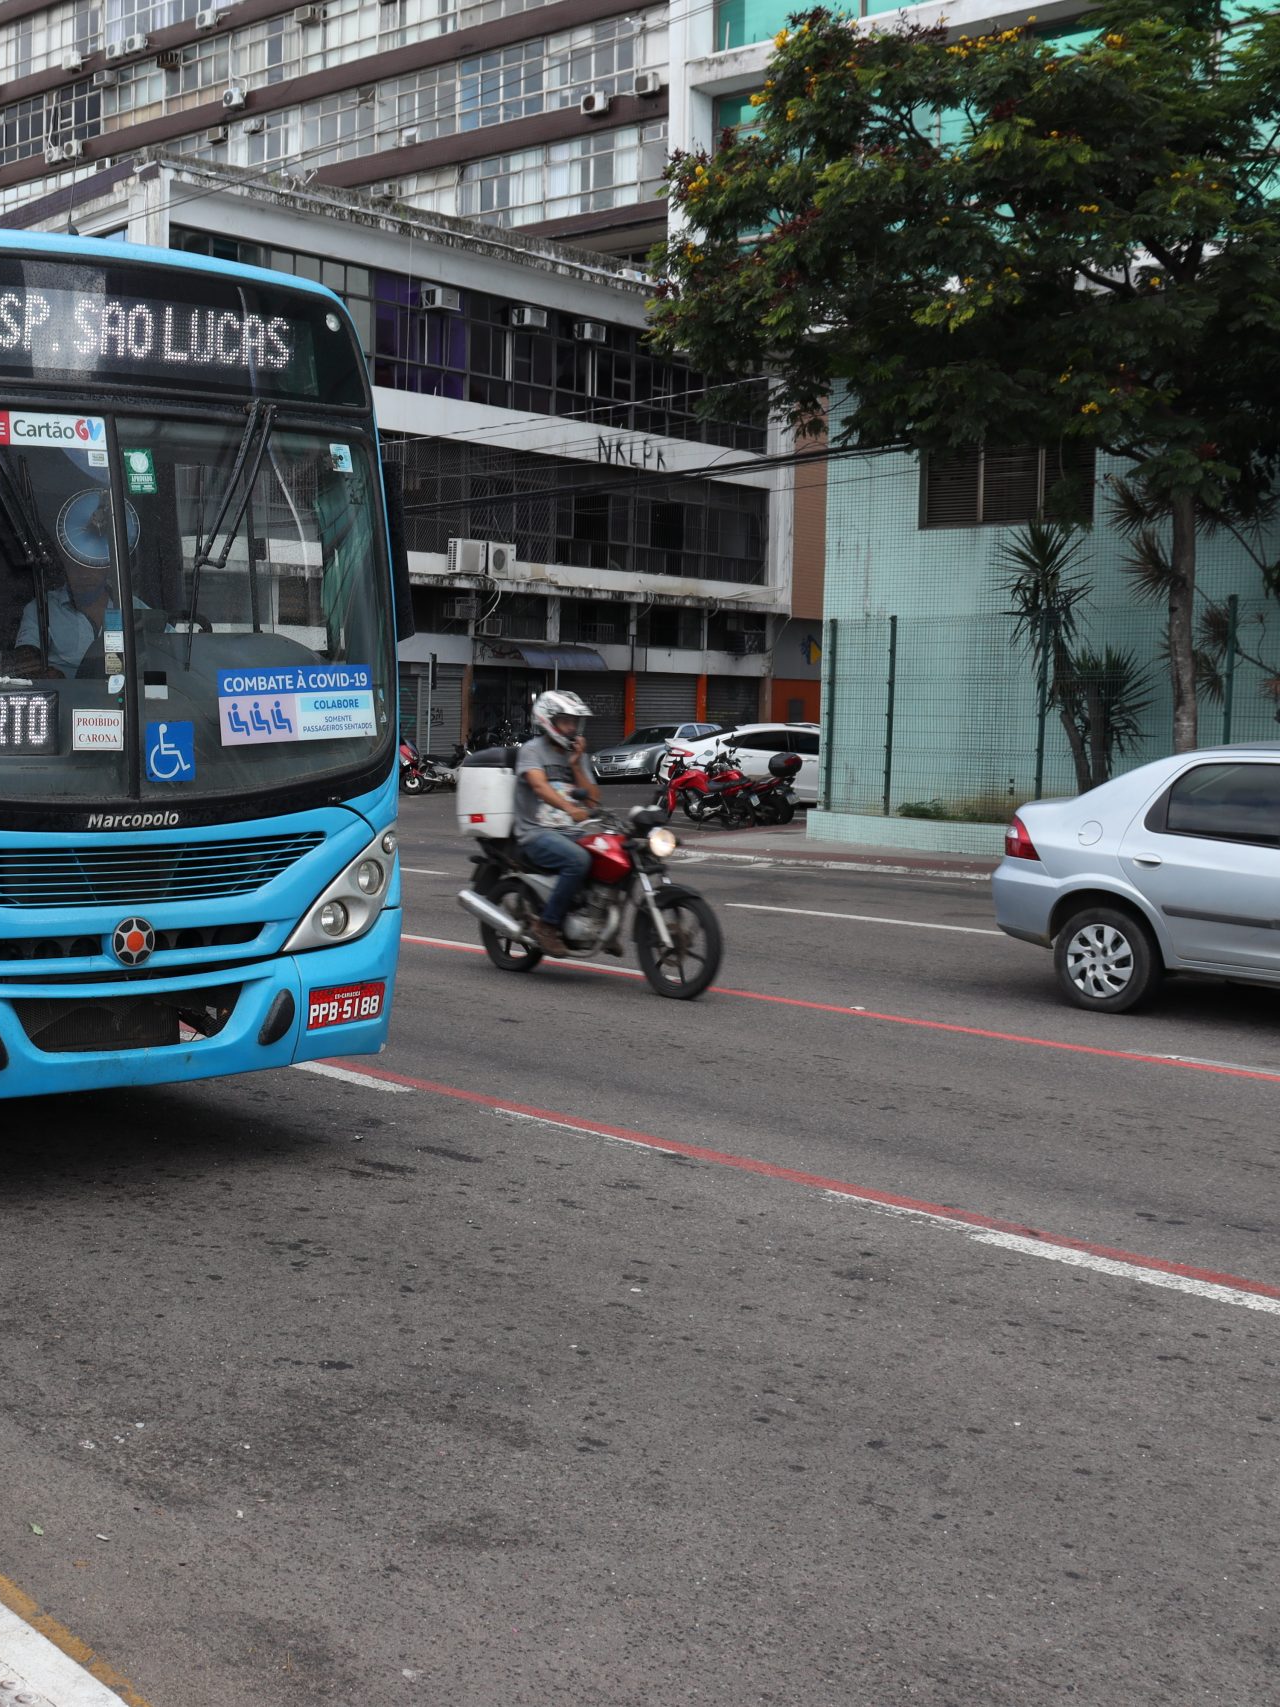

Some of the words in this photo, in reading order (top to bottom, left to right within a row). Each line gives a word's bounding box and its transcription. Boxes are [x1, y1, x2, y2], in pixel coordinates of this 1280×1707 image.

[163, 305, 291, 369] LUCAS
[223, 674, 294, 693] COMBATE
[297, 670, 307, 689] À
[309, 671, 368, 689] COVID-19
[314, 699, 360, 710] COLABORE
[76, 716, 121, 728] PROIBIDO
[303, 723, 344, 732] PASSAGEIROS
[344, 722, 372, 731] SENTADOS
[77, 733, 118, 744] CARONA
[86, 810, 180, 829] Marcopolo
